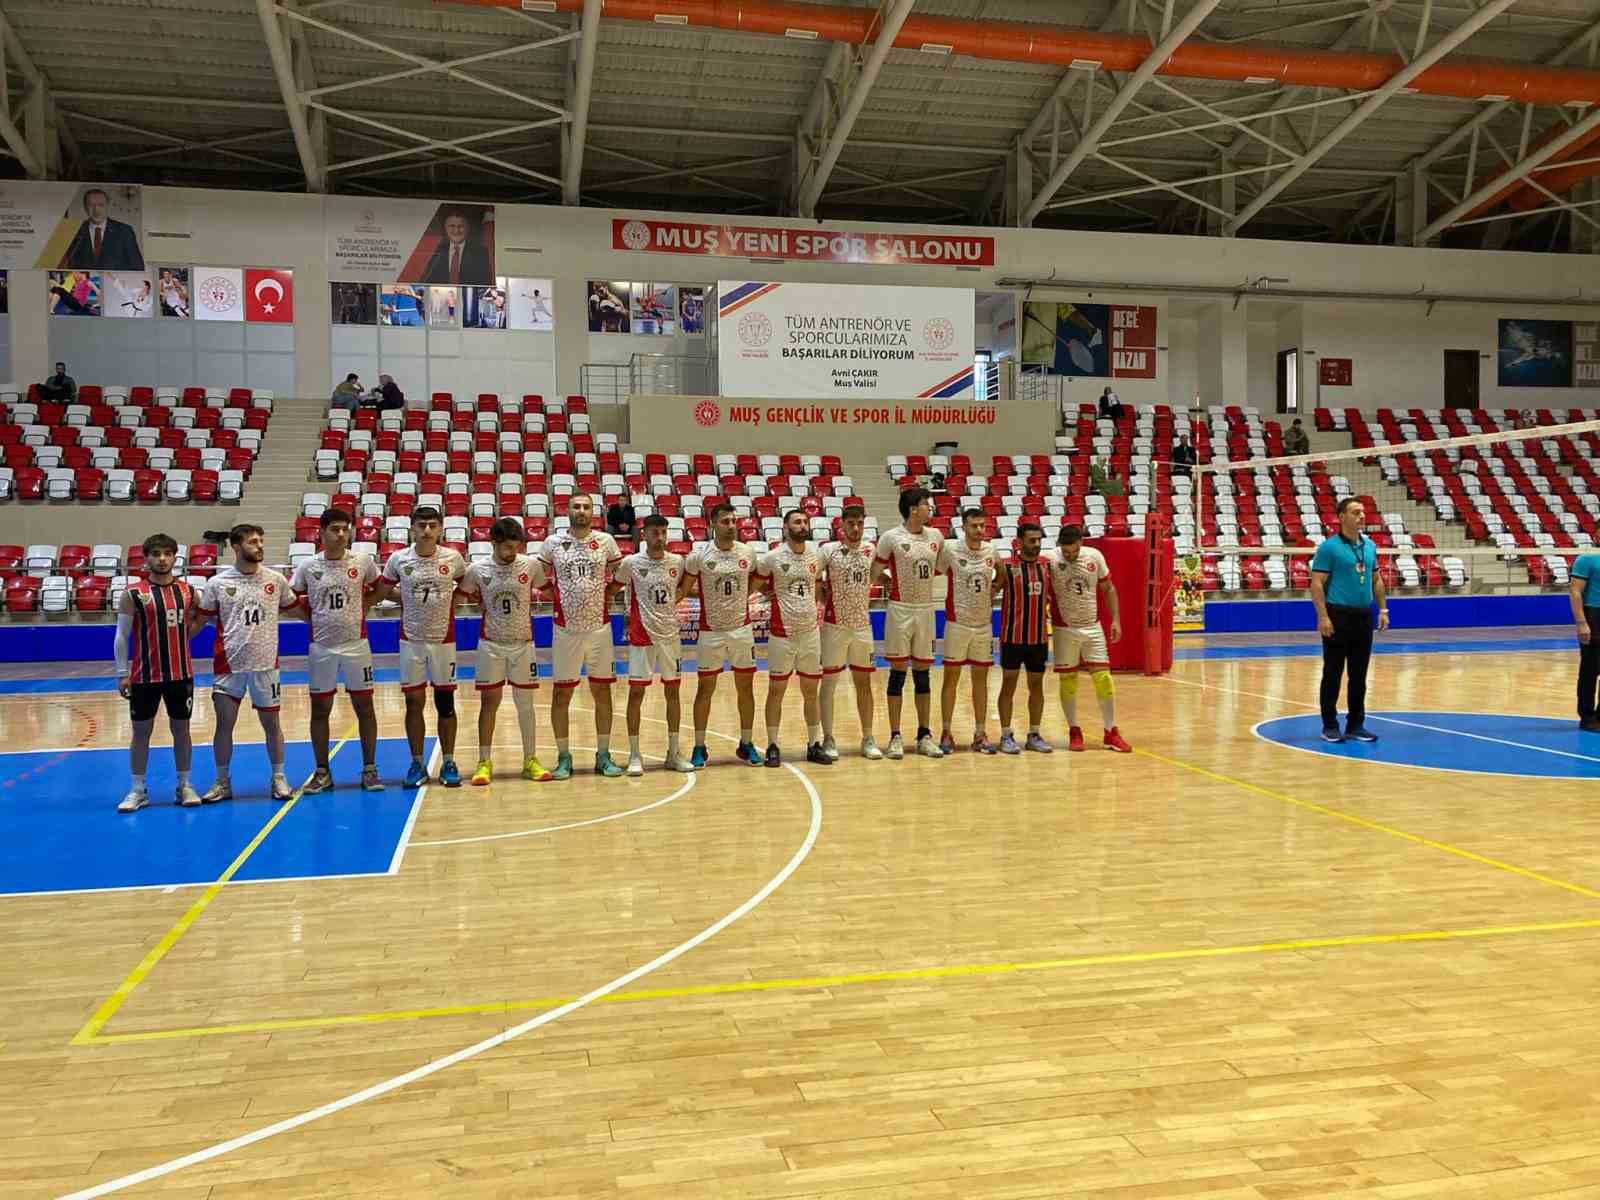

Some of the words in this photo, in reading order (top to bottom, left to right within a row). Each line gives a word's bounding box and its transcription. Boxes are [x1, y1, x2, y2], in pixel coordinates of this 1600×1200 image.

[656, 227, 720, 254] MUŞ
[727, 231, 788, 253] YENİ
[795, 235, 867, 257] SPOR
[874, 238, 982, 261] SALONU
[784, 314, 815, 329] TÜM
[820, 316, 892, 331] ANTRENÖR
[895, 319, 912, 331] VE
[789, 331, 908, 346] SPORCULARIMIZA
[782, 348, 847, 360] BAŞARILAR
[850, 348, 914, 360] DİLİYORUM
[831, 369, 850, 377] Avni
[854, 379, 877, 388] Valisi
[729, 407, 760, 426] MUŞ
[766, 405, 824, 427] GENÇLİK
[830, 407, 847, 423] VE
[853, 408, 889, 424] SPOR
[895, 406, 906, 424] İL
[911, 406, 996, 424] MÜDÜRLÜĞÜ
[919, 565, 930, 579] 18
[725, 581, 732, 595] 8
[798, 584, 804, 597] 4
[975, 579, 982, 592] 5
[329, 593, 343, 609] 16
[422, 588, 430, 603] 7
[655, 590, 668, 604] 12
[503, 599, 511, 614] 9
[244, 609, 260, 626] 14
